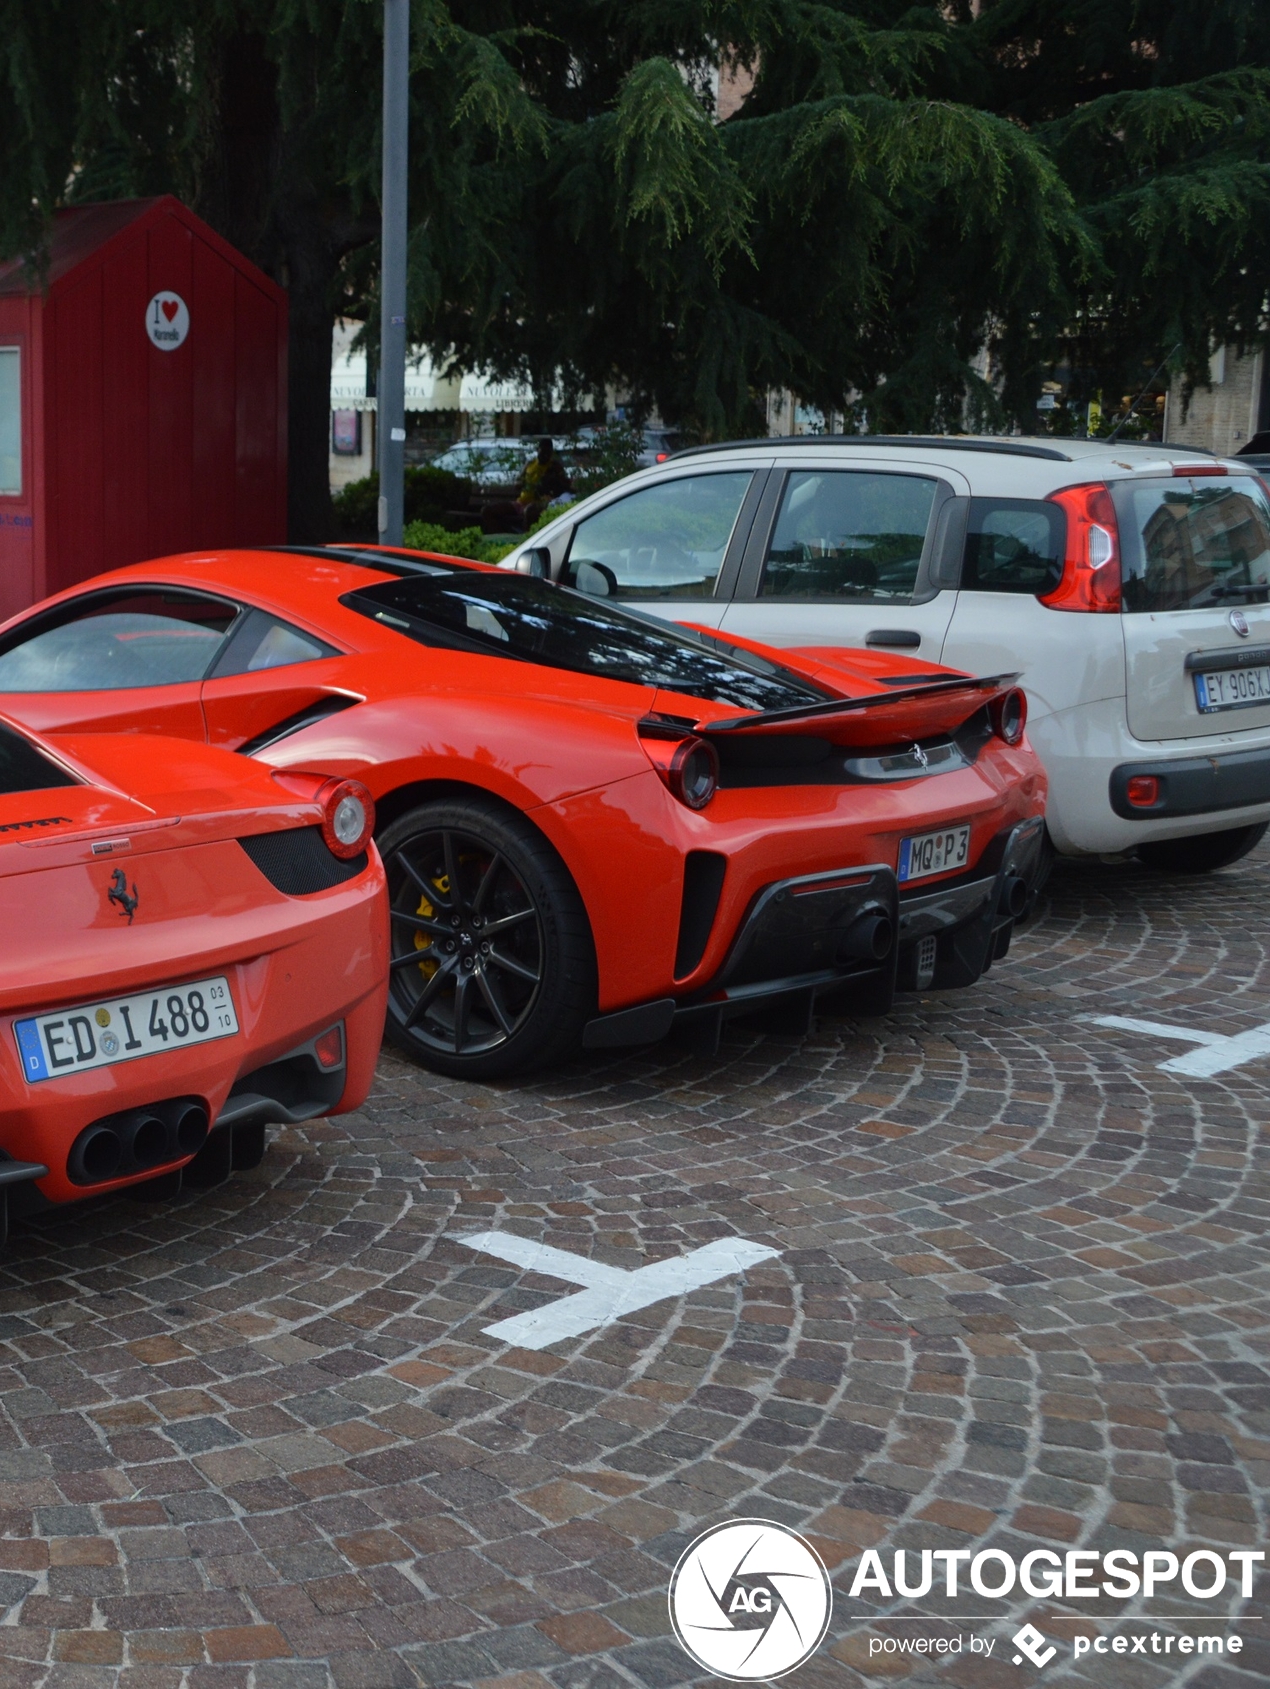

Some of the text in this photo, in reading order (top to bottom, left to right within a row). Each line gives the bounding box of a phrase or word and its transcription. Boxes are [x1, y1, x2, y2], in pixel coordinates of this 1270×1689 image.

[154, 299, 160, 324] I
[467, 386, 512, 397] NUVOLE
[1206, 675, 1223, 703] EY
[910, 829, 968, 874] MQ P 3
[210, 986, 225, 1000] 03
[43, 990, 210, 1068] ED I 488
[218, 1014, 231, 1028] 10
[29, 1056, 40, 1070] D
